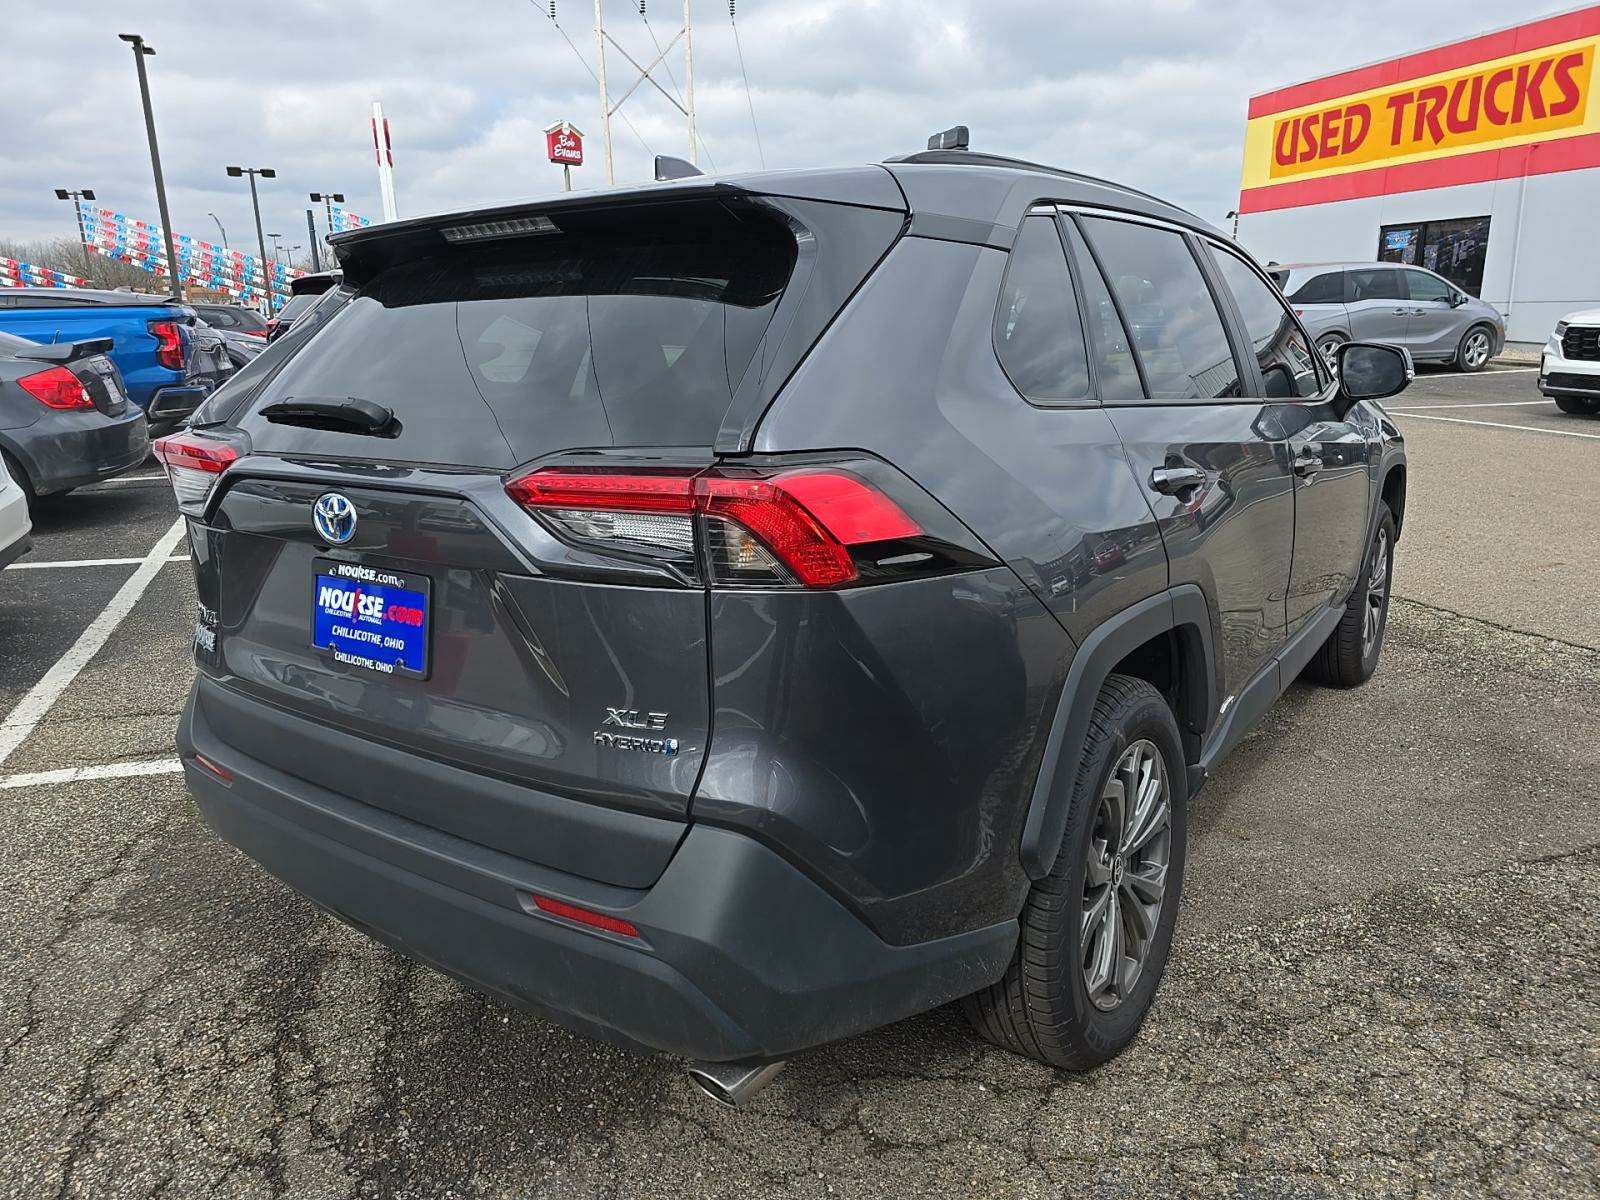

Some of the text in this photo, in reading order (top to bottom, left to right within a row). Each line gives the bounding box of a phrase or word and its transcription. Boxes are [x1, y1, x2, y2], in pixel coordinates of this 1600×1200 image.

[1275, 53, 1584, 166] USED TRUCKS
[554, 144, 582, 159] Evans
[559, 135, 576, 147] Bob
[338, 564, 399, 586] NOURSE.com
[331, 624, 405, 651] CHILLICOTHE, OHIO
[375, 660, 394, 674] OHIO
[602, 707, 669, 730] XLE
[593, 731, 665, 753] HYBRID
